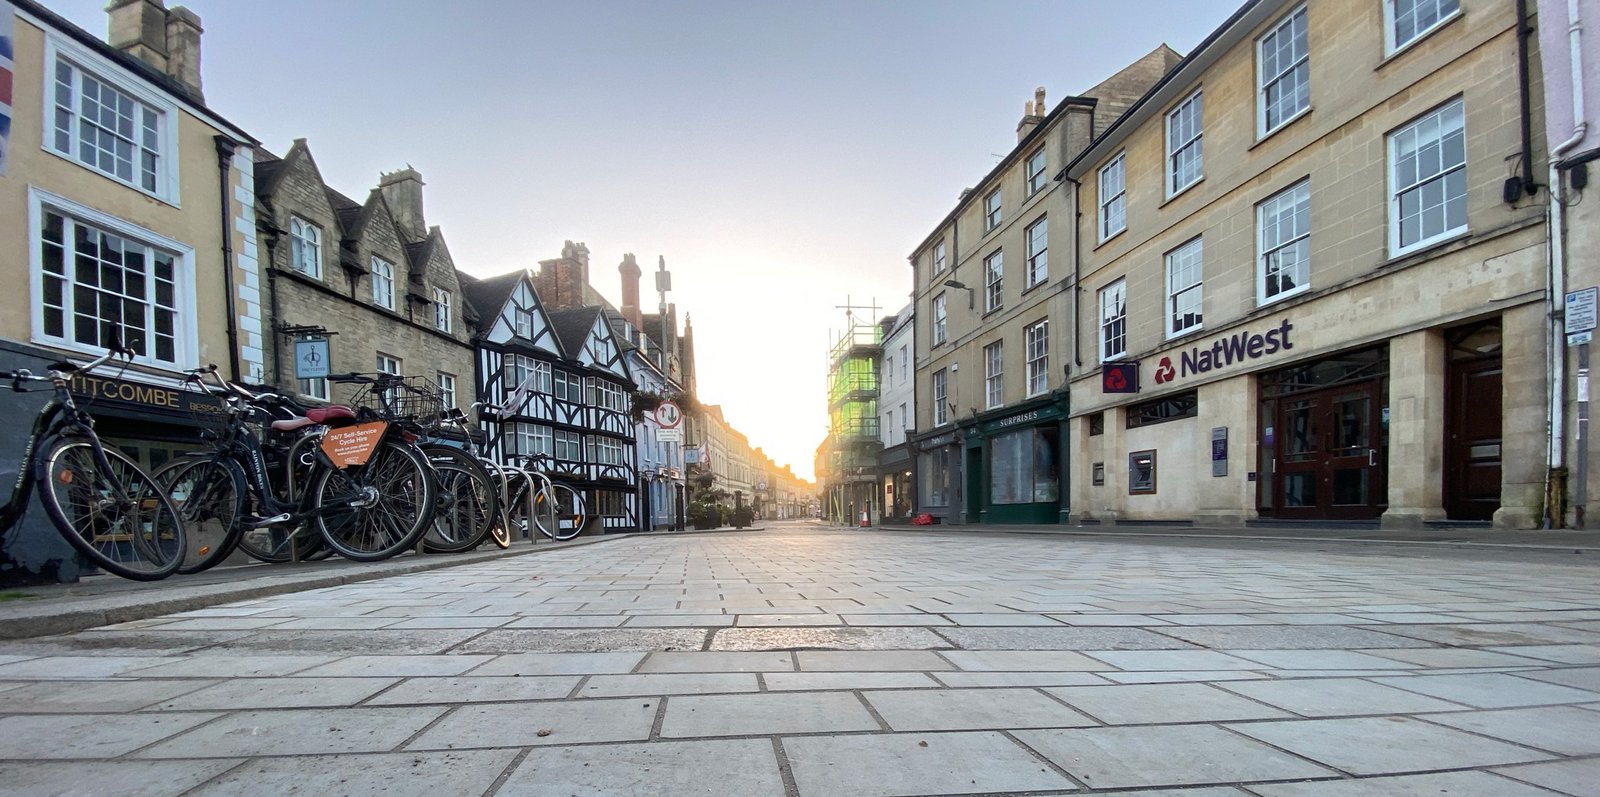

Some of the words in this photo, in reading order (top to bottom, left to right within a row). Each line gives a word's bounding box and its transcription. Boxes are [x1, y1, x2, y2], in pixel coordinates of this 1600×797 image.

[1181, 318, 1293, 378] NatWest
[71, 376, 181, 408] TITCOMBE
[999, 410, 1038, 427] SURPRISES
[330, 433, 343, 441] 24/7
[343, 428, 377, 439] Self-Service
